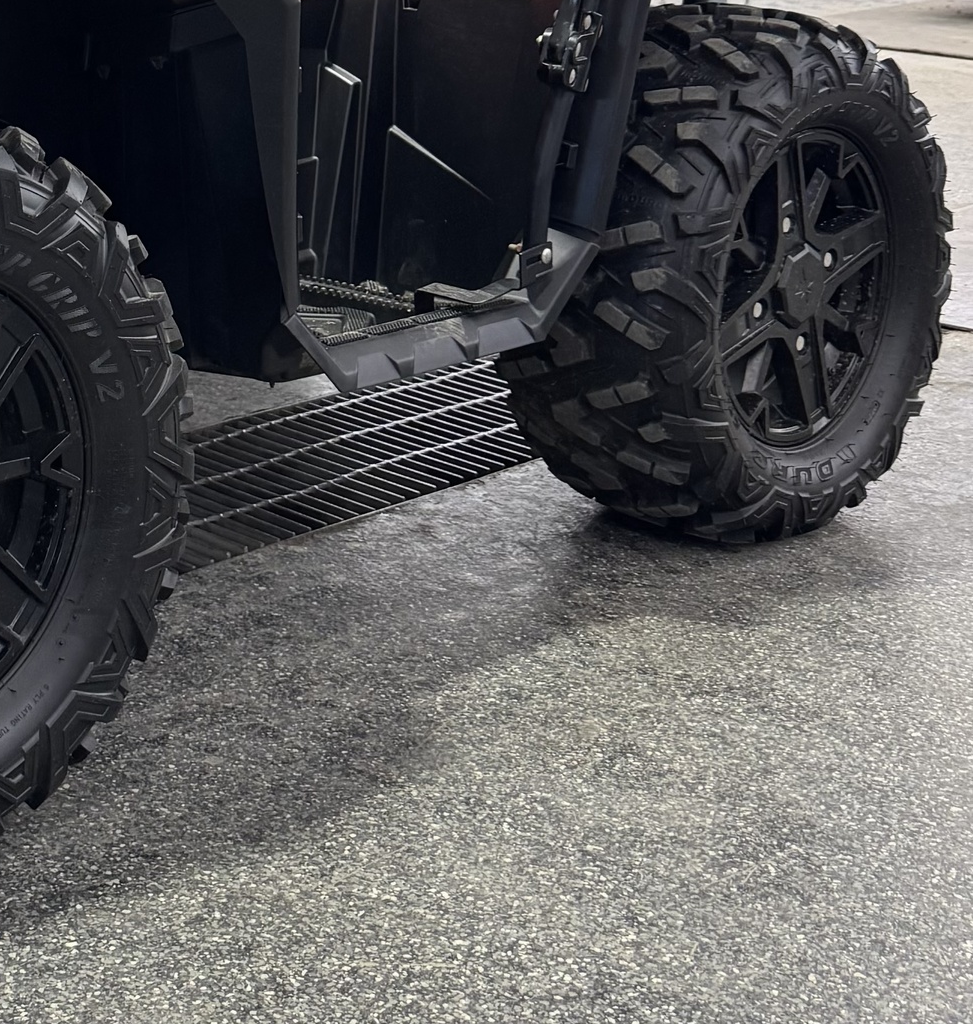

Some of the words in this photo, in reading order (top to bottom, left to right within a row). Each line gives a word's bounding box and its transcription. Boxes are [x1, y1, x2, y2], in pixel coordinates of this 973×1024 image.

[27, 271, 102, 338] GRIP
[89, 348, 125, 403] V2
[32, 690, 45, 705] PLY
[10, 703, 33, 727] RATING
